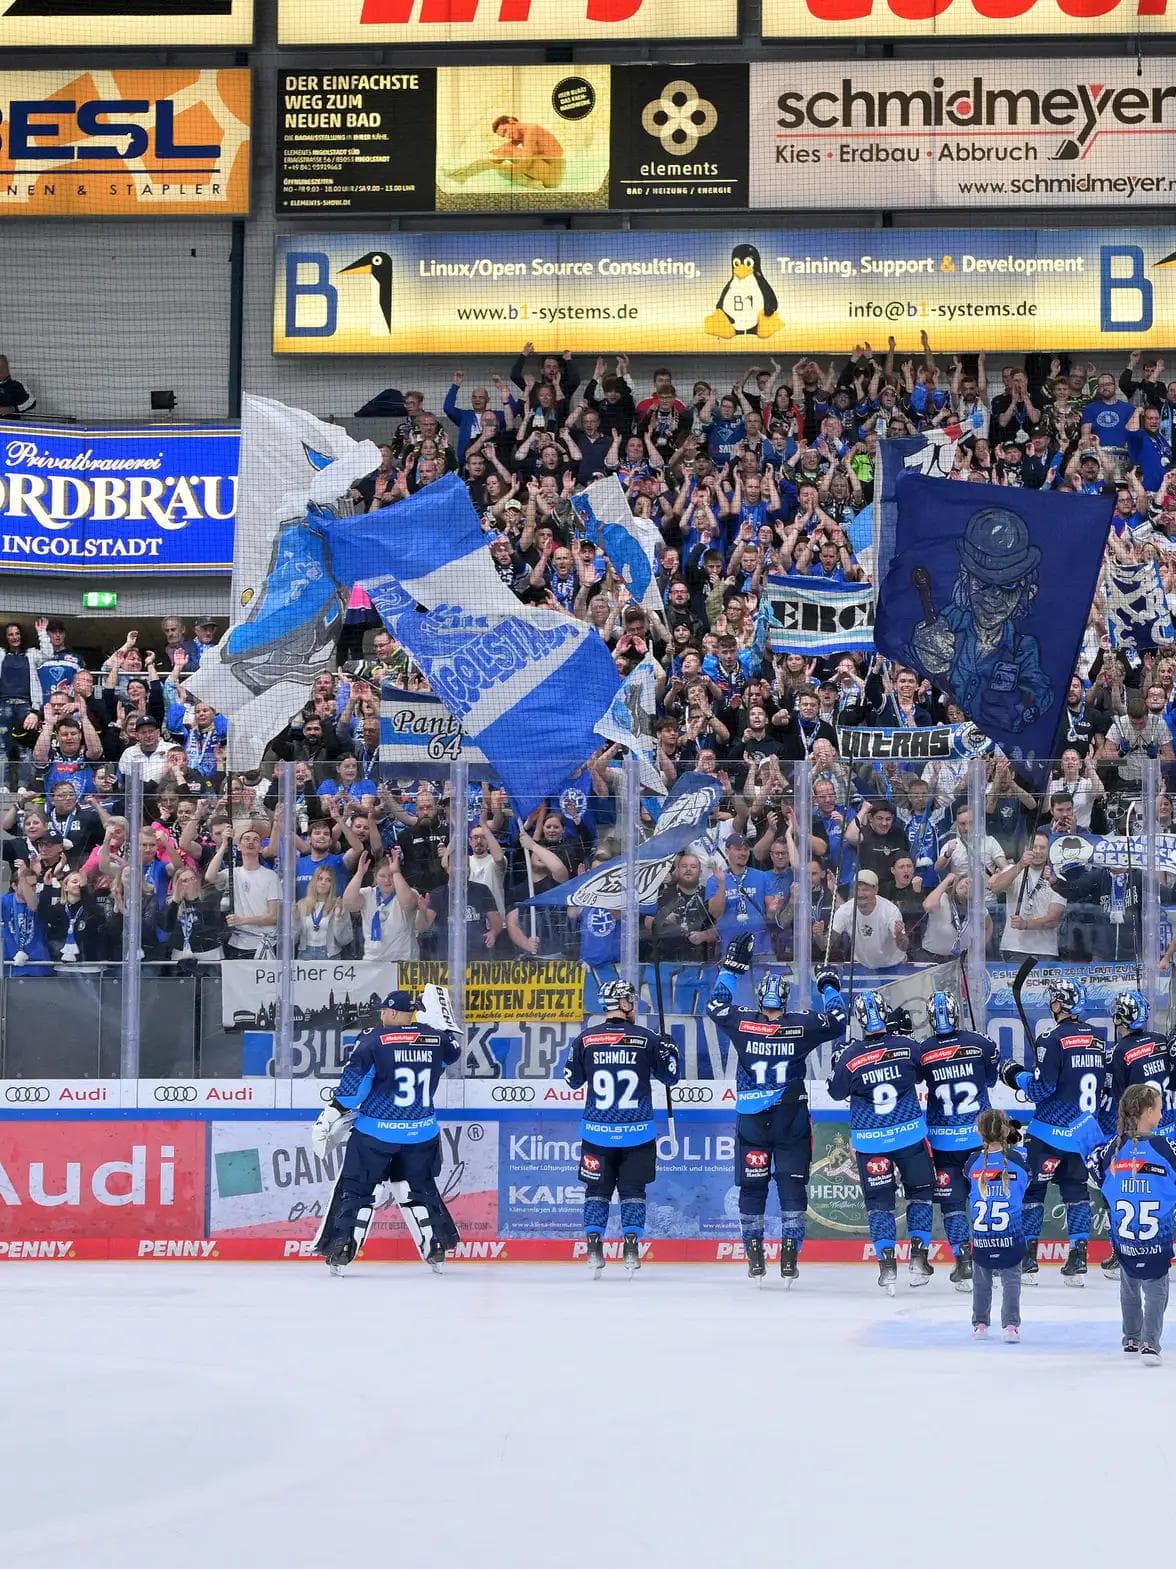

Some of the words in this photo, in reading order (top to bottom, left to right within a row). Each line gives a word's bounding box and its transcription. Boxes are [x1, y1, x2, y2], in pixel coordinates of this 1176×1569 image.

[285, 75, 319, 91] DER
[323, 74, 419, 90] EINFACHSTE
[284, 95, 323, 110] WEG
[326, 94, 363, 109] ZUM
[776, 76, 1176, 147] schmidmeyer
[0, 100, 221, 160] ESL
[284, 113, 342, 128] NEUEN
[346, 112, 382, 128] BAD
[776, 144, 821, 164] Kies
[839, 144, 921, 164] Erdbau
[938, 143, 1038, 162] Abbruch
[640, 161, 719, 176] elements
[110, 183, 220, 195] STAPLER
[626, 187, 643, 195] BAD
[652, 186, 688, 195] HEIZUNG
[697, 186, 732, 194] ENERGIE
[419, 258, 526, 281] Linux/Open
[531, 258, 593, 277] Source
[598, 258, 701, 280] Consulting,
[777, 256, 858, 278] Training,
[861, 256, 935, 277] Support
[940, 255, 956, 273] &
[962, 255, 1084, 276] Development
[457, 304, 638, 323] www.b1-systems.de
[848, 301, 1037, 320] info@b1-systems.de
[6, 440, 164, 471] Privatbrauerei
[0, 472, 239, 530] RDBRÄU
[3, 535, 163, 557] INGOLSTADT
[428, 733, 462, 760] 64
[333, 964, 357, 982] 64
[399, 960, 583, 985] KENNZCHNUNGSPFLICHT
[526, 988, 576, 1011] JETZT
[394, 1050, 433, 1063] WILLIAMS
[593, 1050, 637, 1065] SCHMÖLZ
[745, 1040, 795, 1055] AGOSTINO
[750, 1061, 789, 1085] 11
[862, 1064, 902, 1084] POWELL
[932, 1063, 974, 1082] DUNHAM
[1143, 1058, 1166, 1077] SHEEN
[58, 1087, 107, 1101] Audi
[206, 1087, 253, 1101] Audi
[393, 1068, 432, 1108] 31
[543, 1087, 585, 1101] Aud
[592, 1069, 640, 1110] 92
[1079, 1073, 1098, 1114] 8
[872, 1083, 899, 1115] 9
[935, 1081, 980, 1116] 12
[585, 1123, 649, 1134] INGOLSTADT
[856, 1120, 921, 1140] INGOLSTADT
[690, 1164, 703, 1172] und
[1121, 1177, 1152, 1194] HÜTTL
[973, 1201, 1010, 1232] 25
[1115, 1200, 1161, 1241] 25
